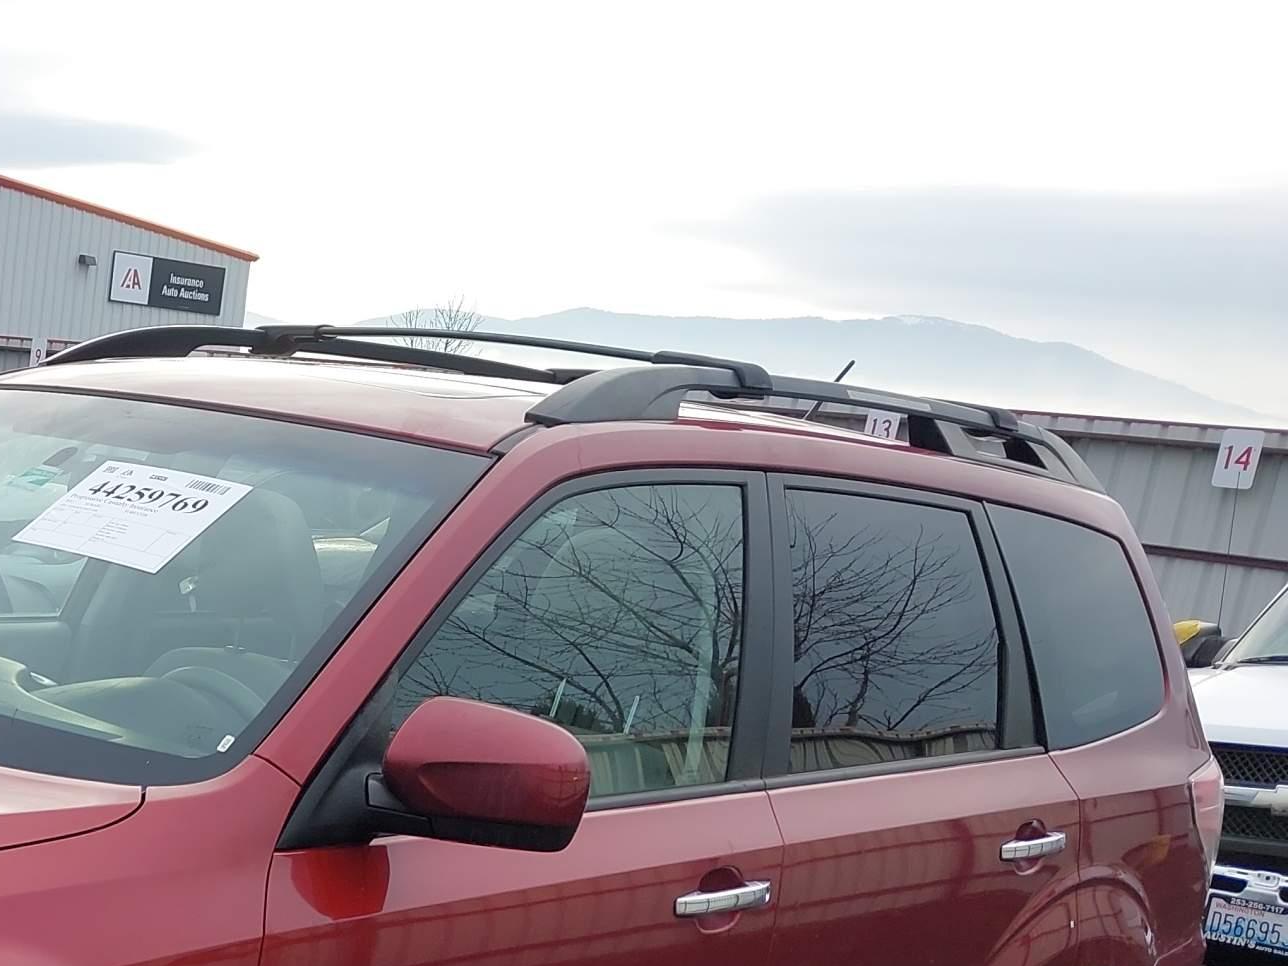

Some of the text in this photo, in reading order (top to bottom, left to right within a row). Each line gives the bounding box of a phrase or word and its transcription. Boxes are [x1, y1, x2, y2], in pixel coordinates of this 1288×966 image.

[169, 272, 204, 289] Insurance
[161, 285, 210, 302] Auto Auctions
[35, 348, 42, 363] 9
[871, 417, 892, 438] 13
[1224, 445, 1253, 471] 14
[89, 480, 209, 514] 44259769
[1204, 930, 1256, 949] AUSTIN'S
